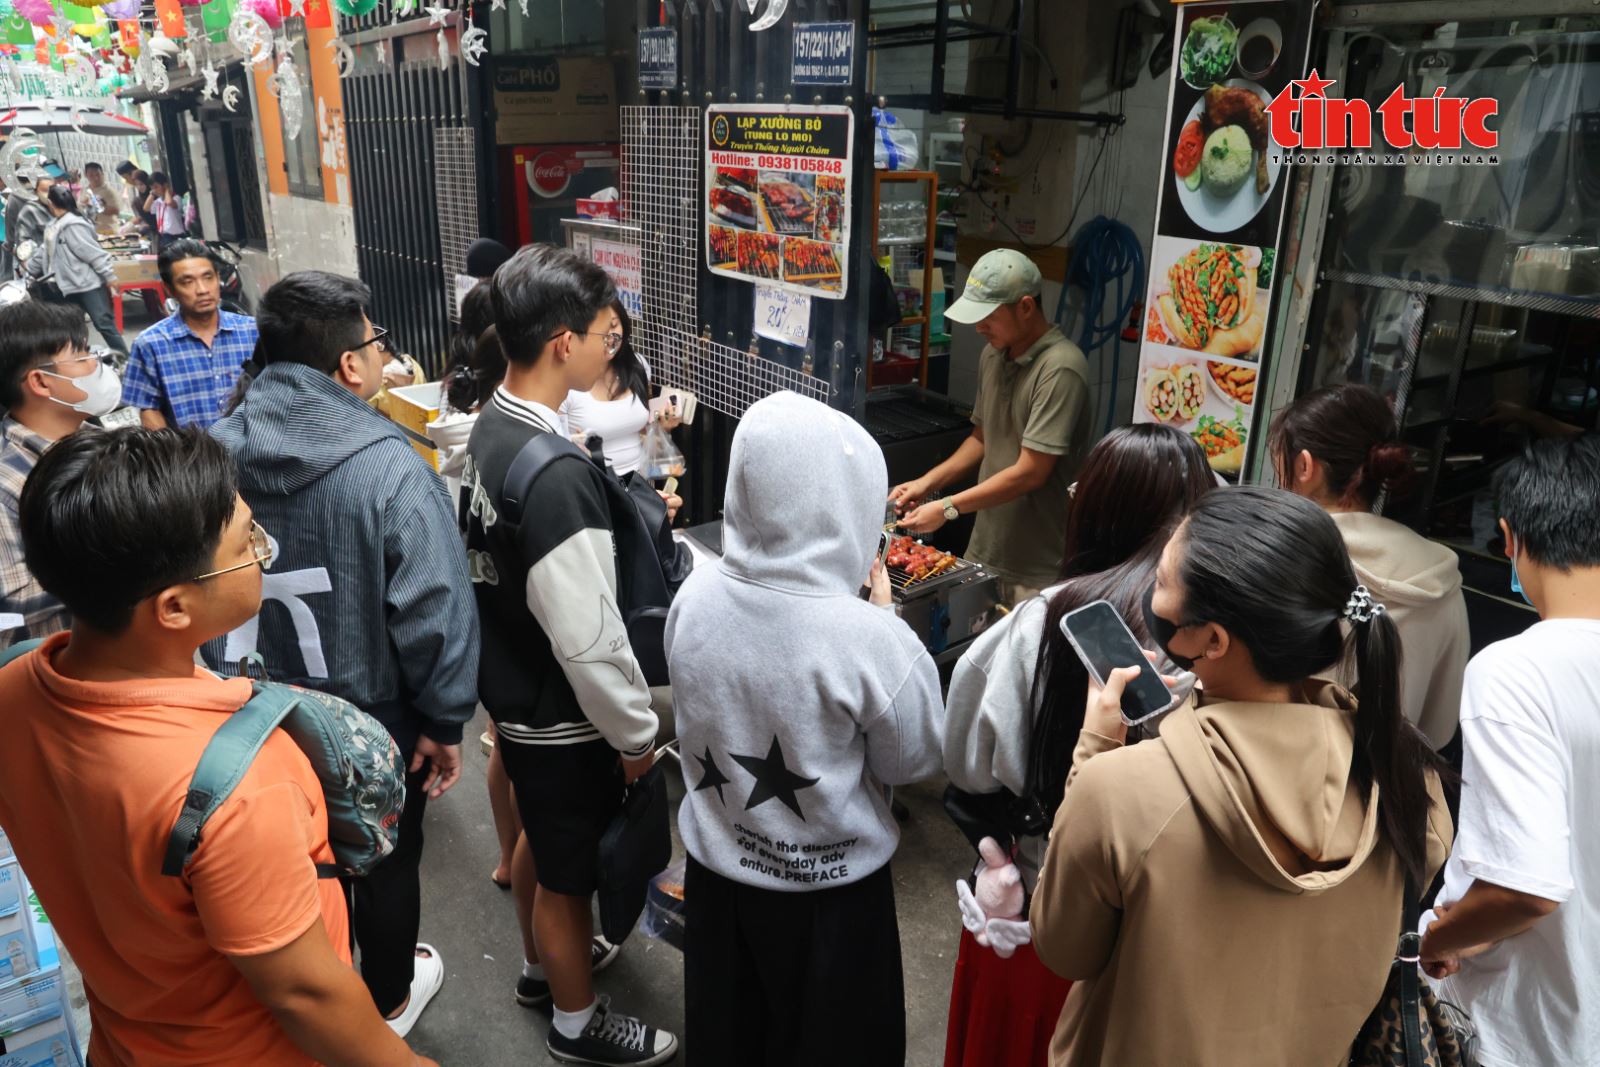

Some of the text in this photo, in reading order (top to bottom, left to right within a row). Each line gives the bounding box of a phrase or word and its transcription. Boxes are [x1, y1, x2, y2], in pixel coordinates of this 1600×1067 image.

[712, 152, 842, 174] Hotline: 0938105848
[776, 840, 798, 853] the
[802, 837, 858, 853] disarray
[740, 857, 848, 882] enture.PREFACE
[758, 848, 816, 870] everyday
[821, 851, 845, 865] adv
